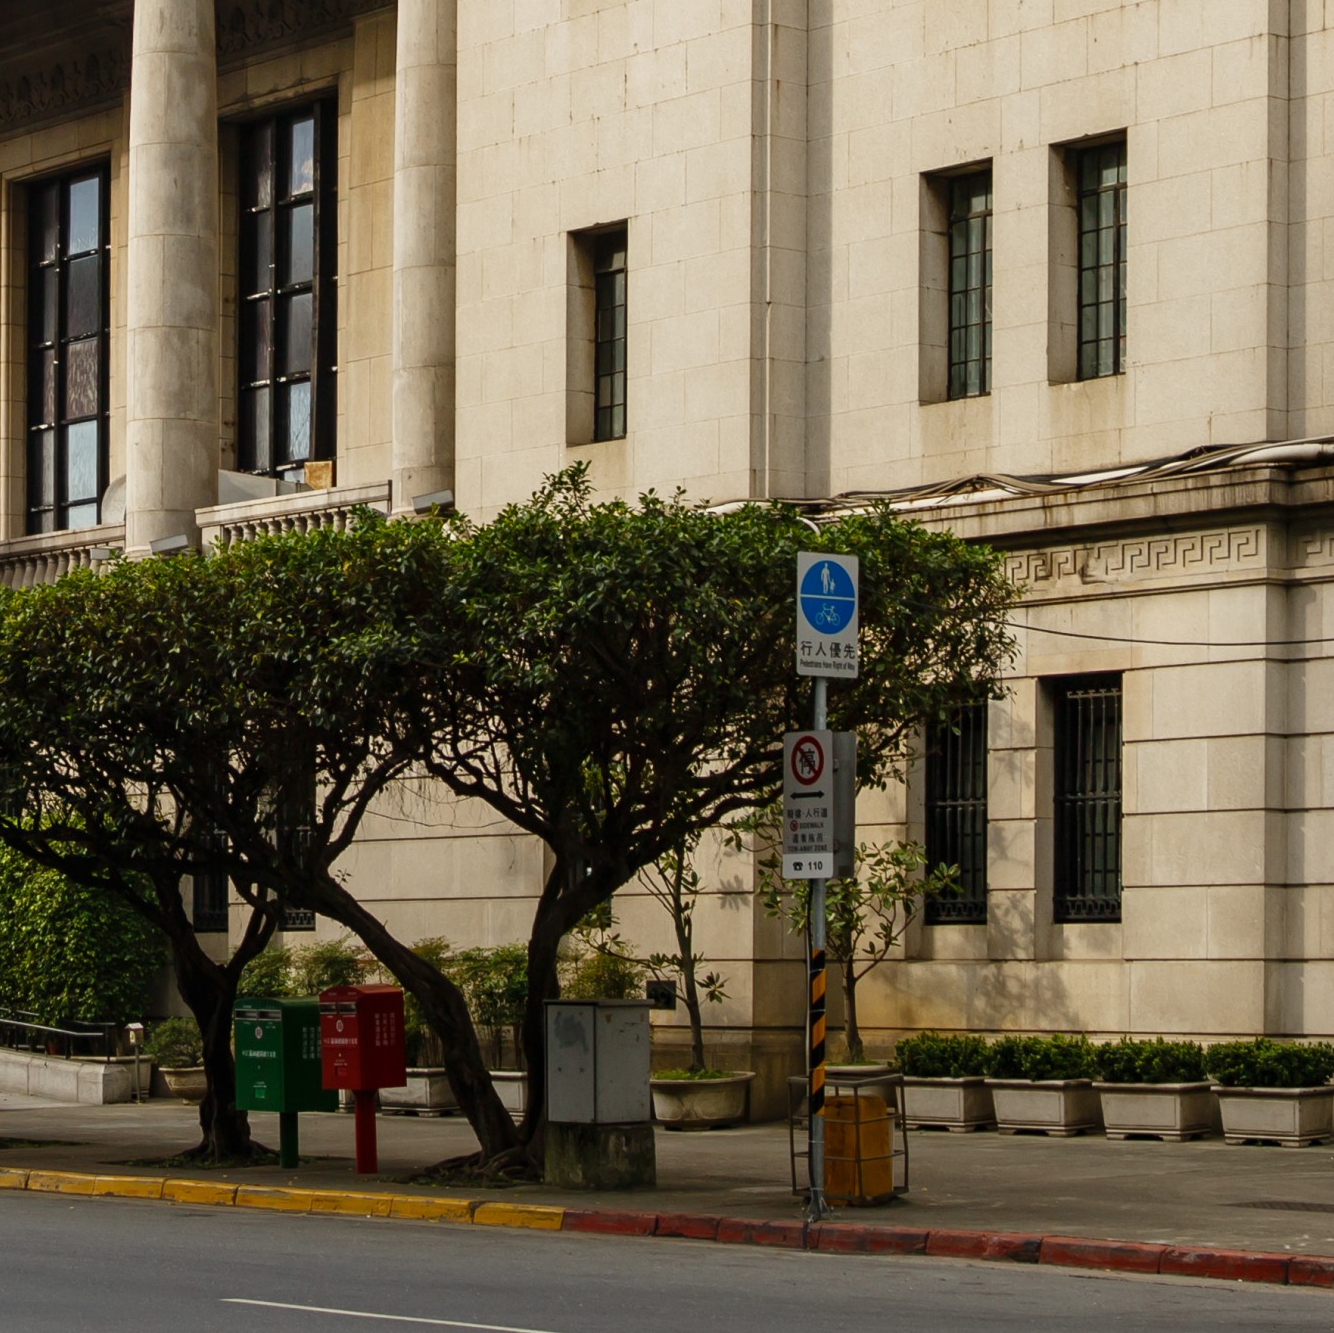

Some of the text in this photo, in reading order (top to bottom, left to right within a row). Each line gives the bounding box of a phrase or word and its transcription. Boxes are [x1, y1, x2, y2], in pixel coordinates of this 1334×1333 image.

[800, 640, 856, 659] 行人優先
[808, 861, 823, 871] 110
